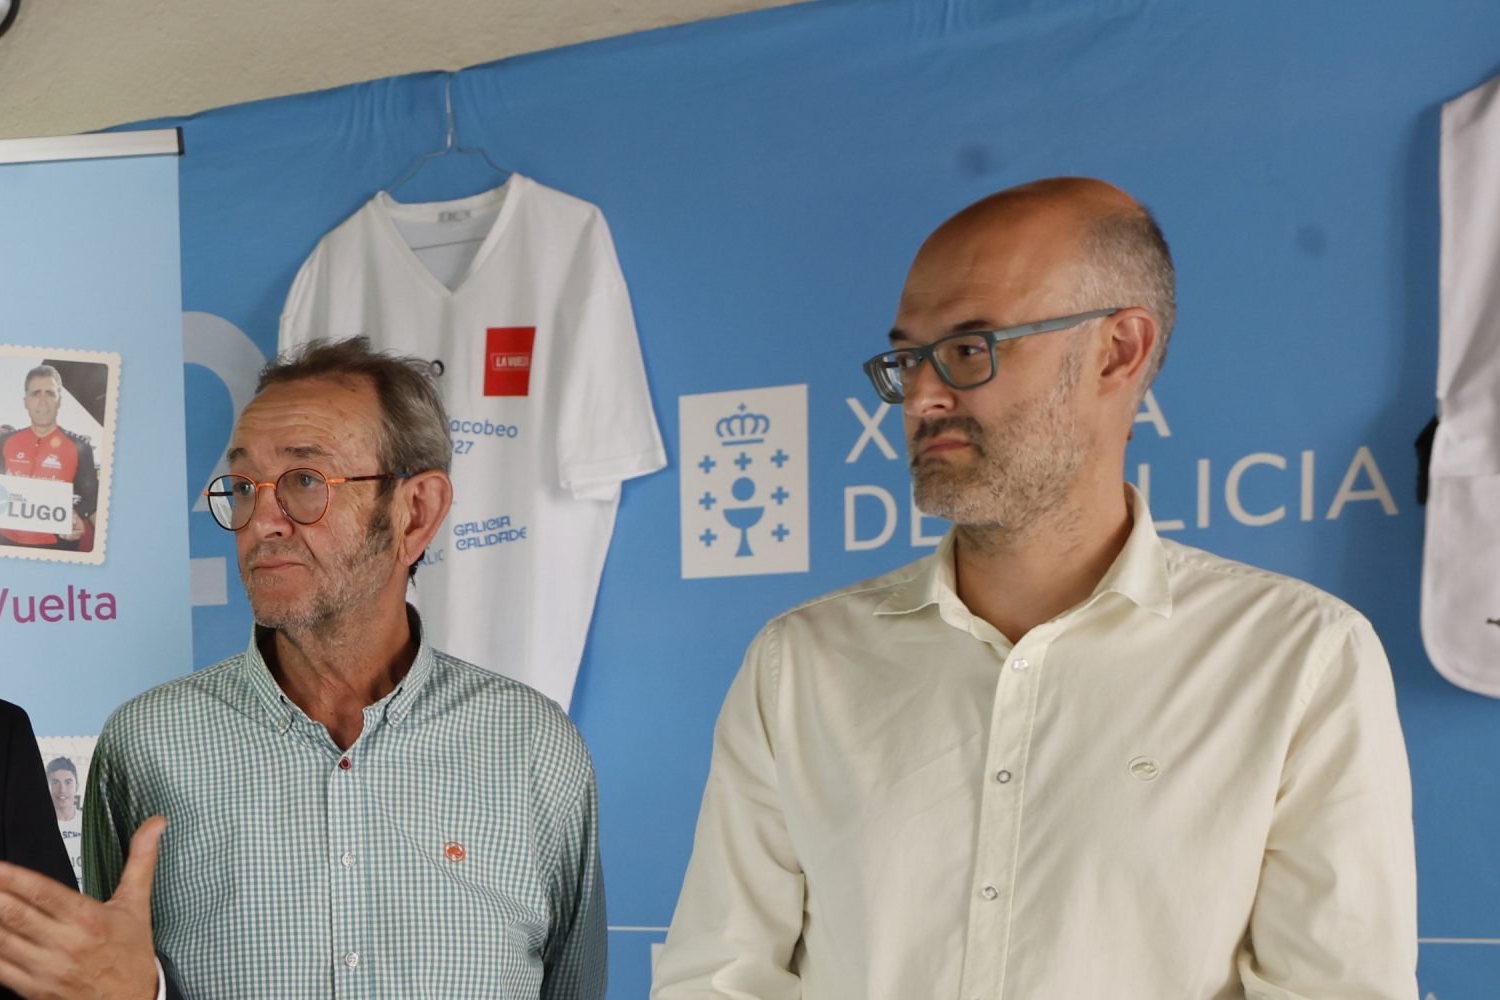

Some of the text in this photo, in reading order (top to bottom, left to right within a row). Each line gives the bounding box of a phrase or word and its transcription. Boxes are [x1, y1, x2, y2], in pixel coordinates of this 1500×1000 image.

[449, 415, 518, 438] acobeo
[1138, 445, 1399, 532] LICIA
[7, 501, 66, 522] LUGO
[453, 515, 511, 537] GALICIA
[456, 526, 527, 551] CALIDADE
